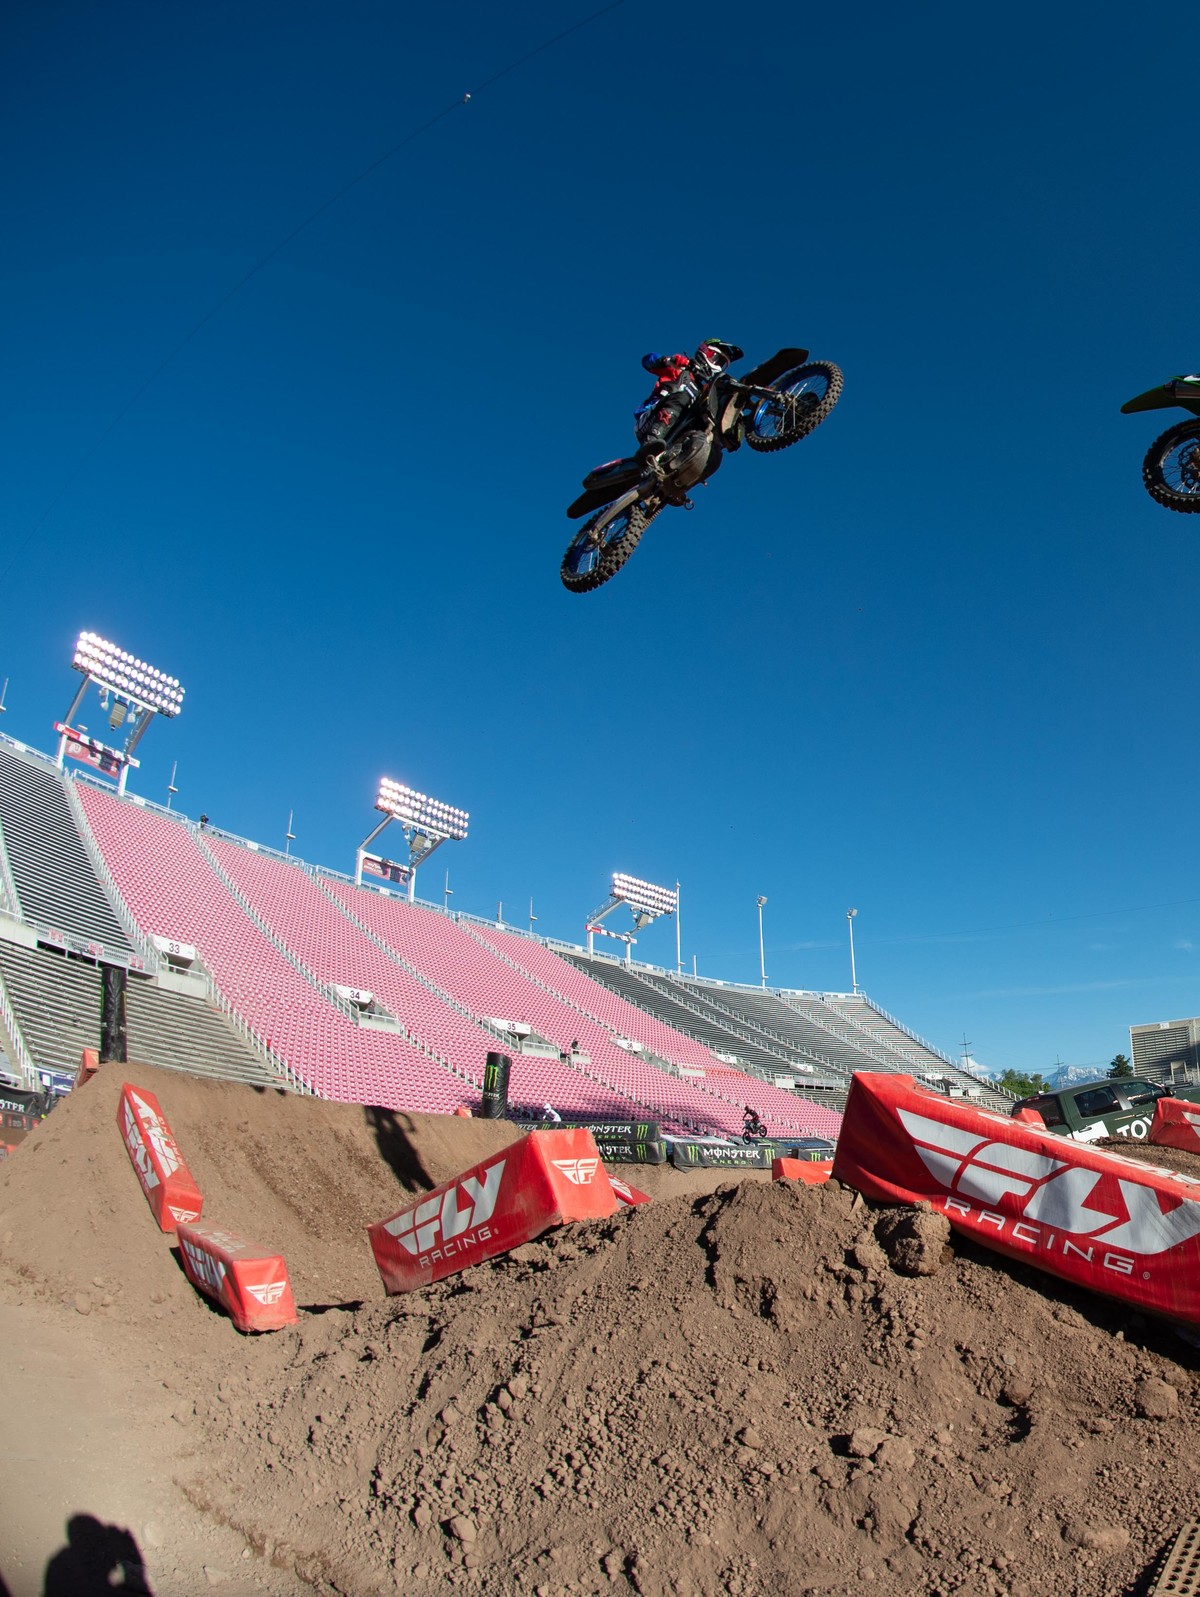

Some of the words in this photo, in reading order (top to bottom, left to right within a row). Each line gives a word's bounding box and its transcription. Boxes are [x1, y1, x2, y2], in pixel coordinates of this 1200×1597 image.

[169, 942, 180, 954] 33
[350, 989, 360, 1000] 34
[507, 1022, 516, 1031] 35
[703, 1148, 761, 1159] MONSTER
[383, 1159, 507, 1256] FLY
[943, 1196, 1136, 1276] RACING
[419, 1226, 492, 1269] RACING
